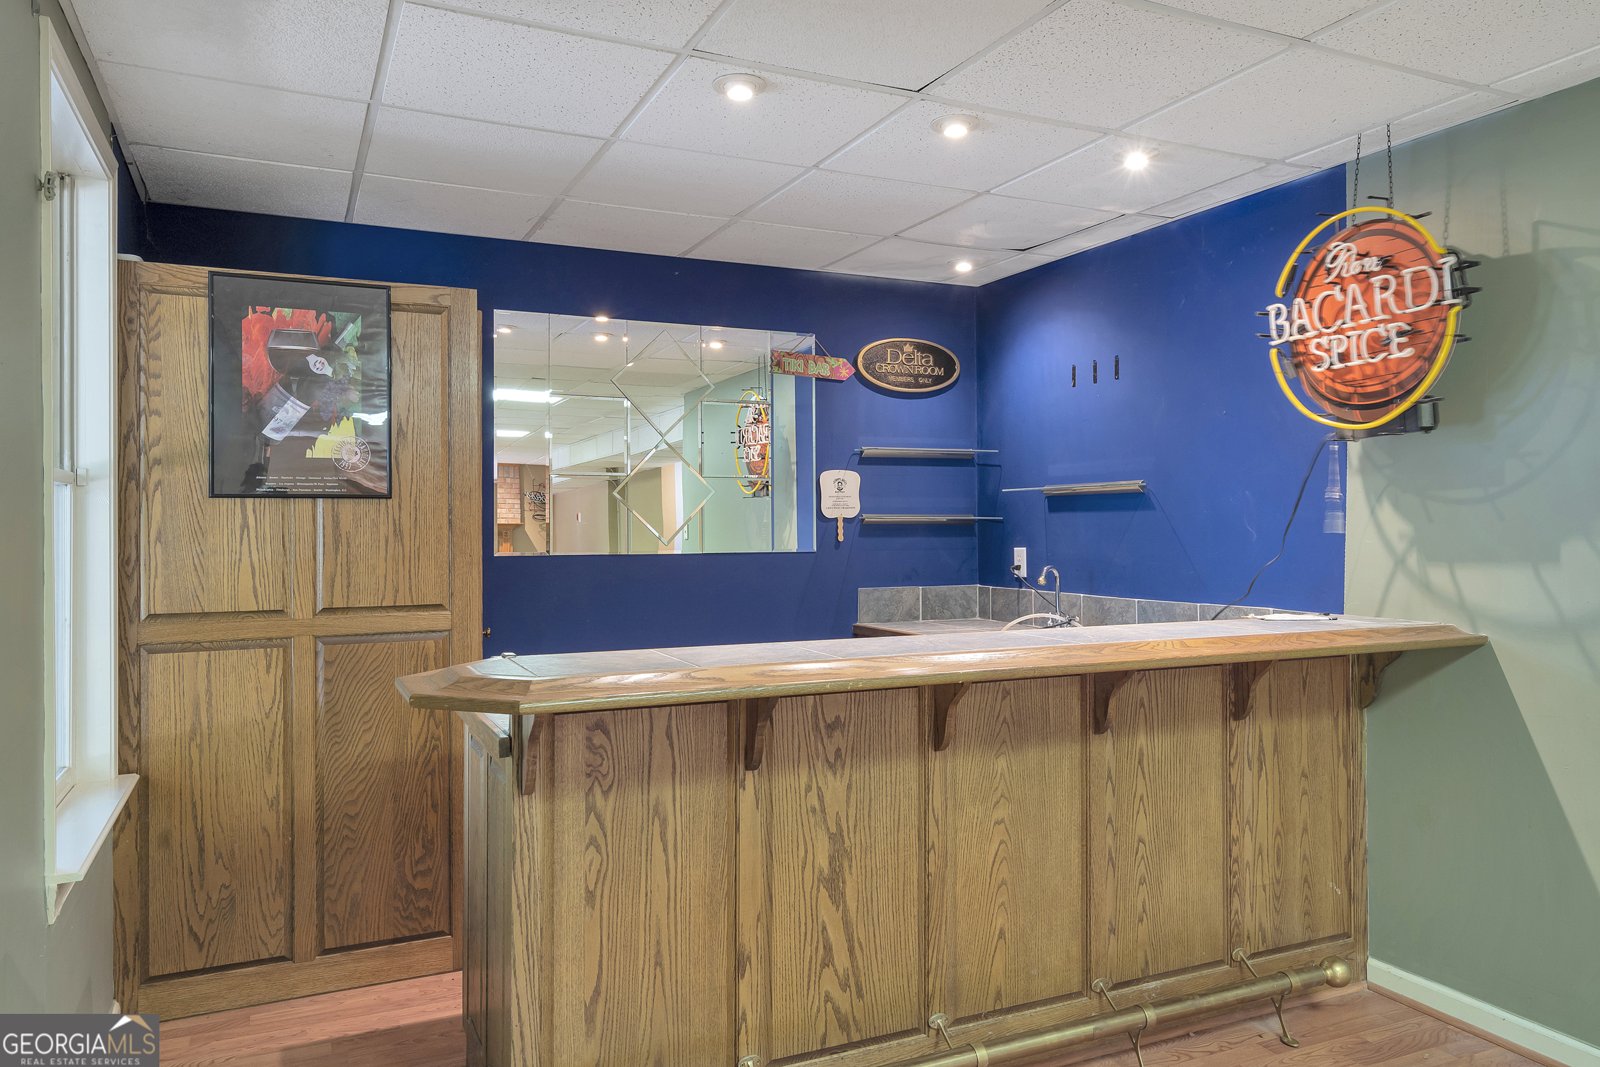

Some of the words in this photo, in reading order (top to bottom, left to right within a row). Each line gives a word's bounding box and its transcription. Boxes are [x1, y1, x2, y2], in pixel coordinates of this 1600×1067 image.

[1266, 256, 1463, 346] BACARDI
[1308, 322, 1415, 373] SPICE
[886, 348, 934, 366] Delta
[782, 357, 804, 373] TIKI
[808, 360, 831, 376] BAR
[875, 362, 913, 374] CROWN
[914, 365, 944, 376] ROOM
[887, 375, 915, 383] MEMBERS
